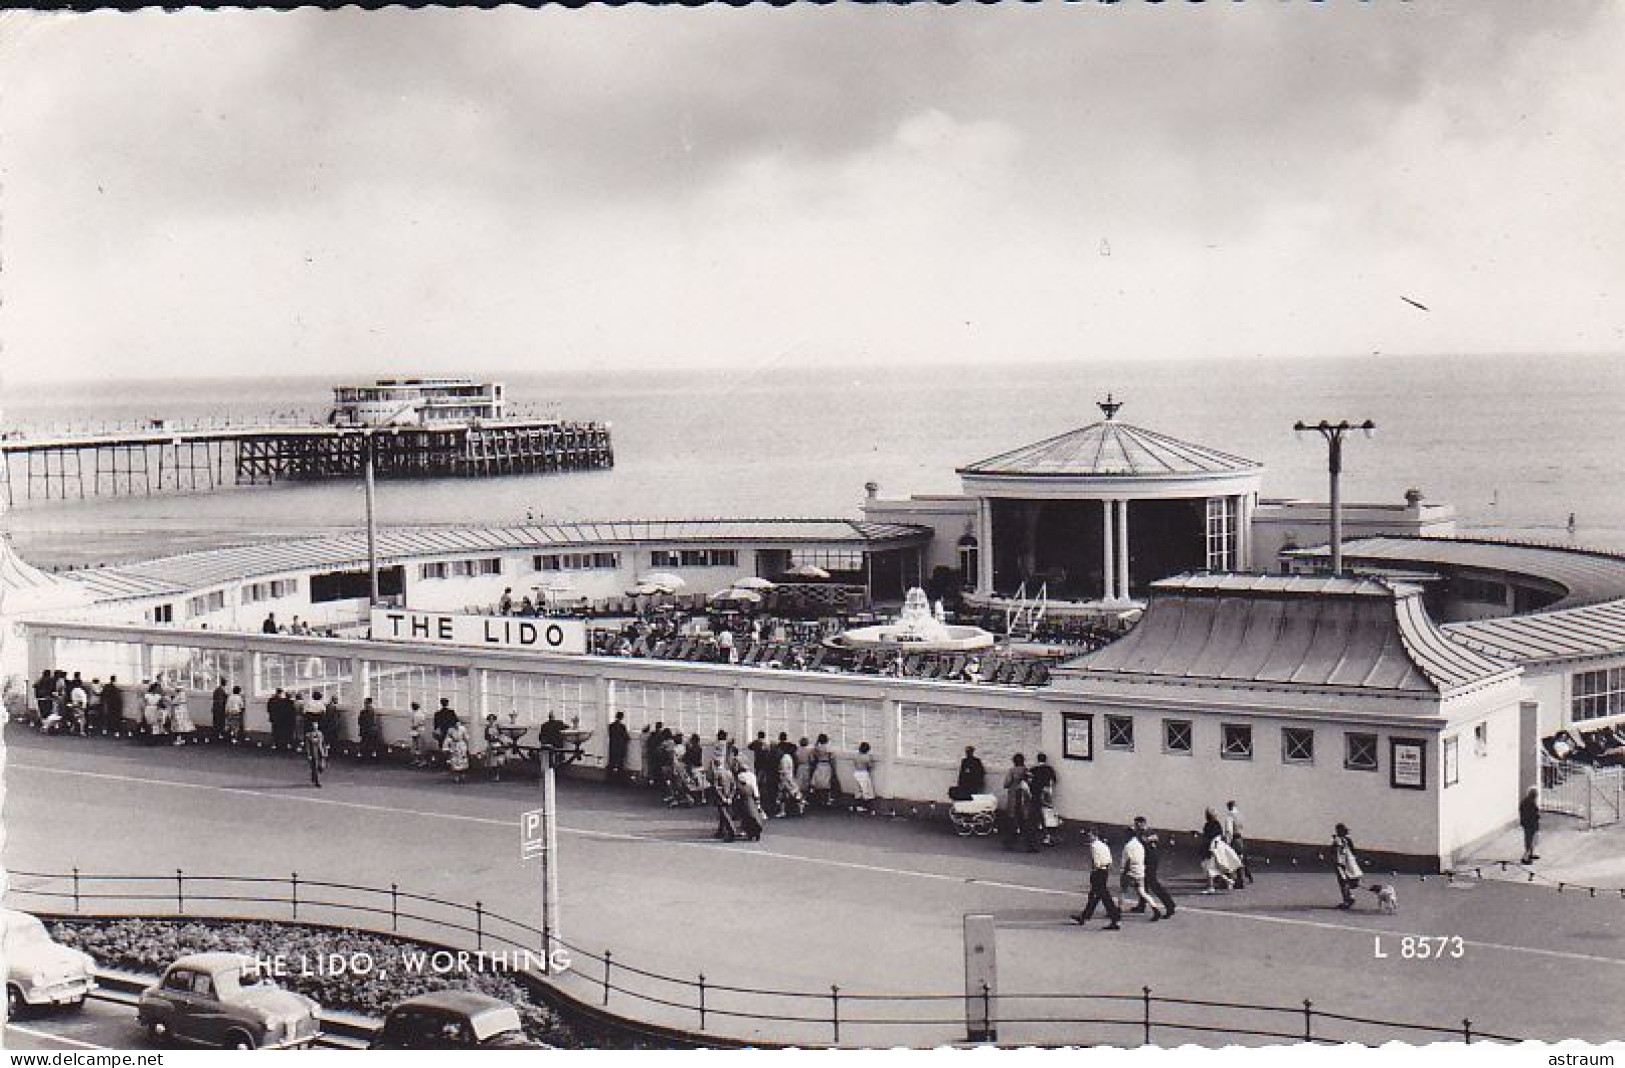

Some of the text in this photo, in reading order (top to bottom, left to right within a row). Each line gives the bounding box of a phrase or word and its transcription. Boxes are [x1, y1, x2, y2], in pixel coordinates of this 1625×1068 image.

[387, 614, 564, 647] THE LIDO
[528, 814, 540, 839] P
